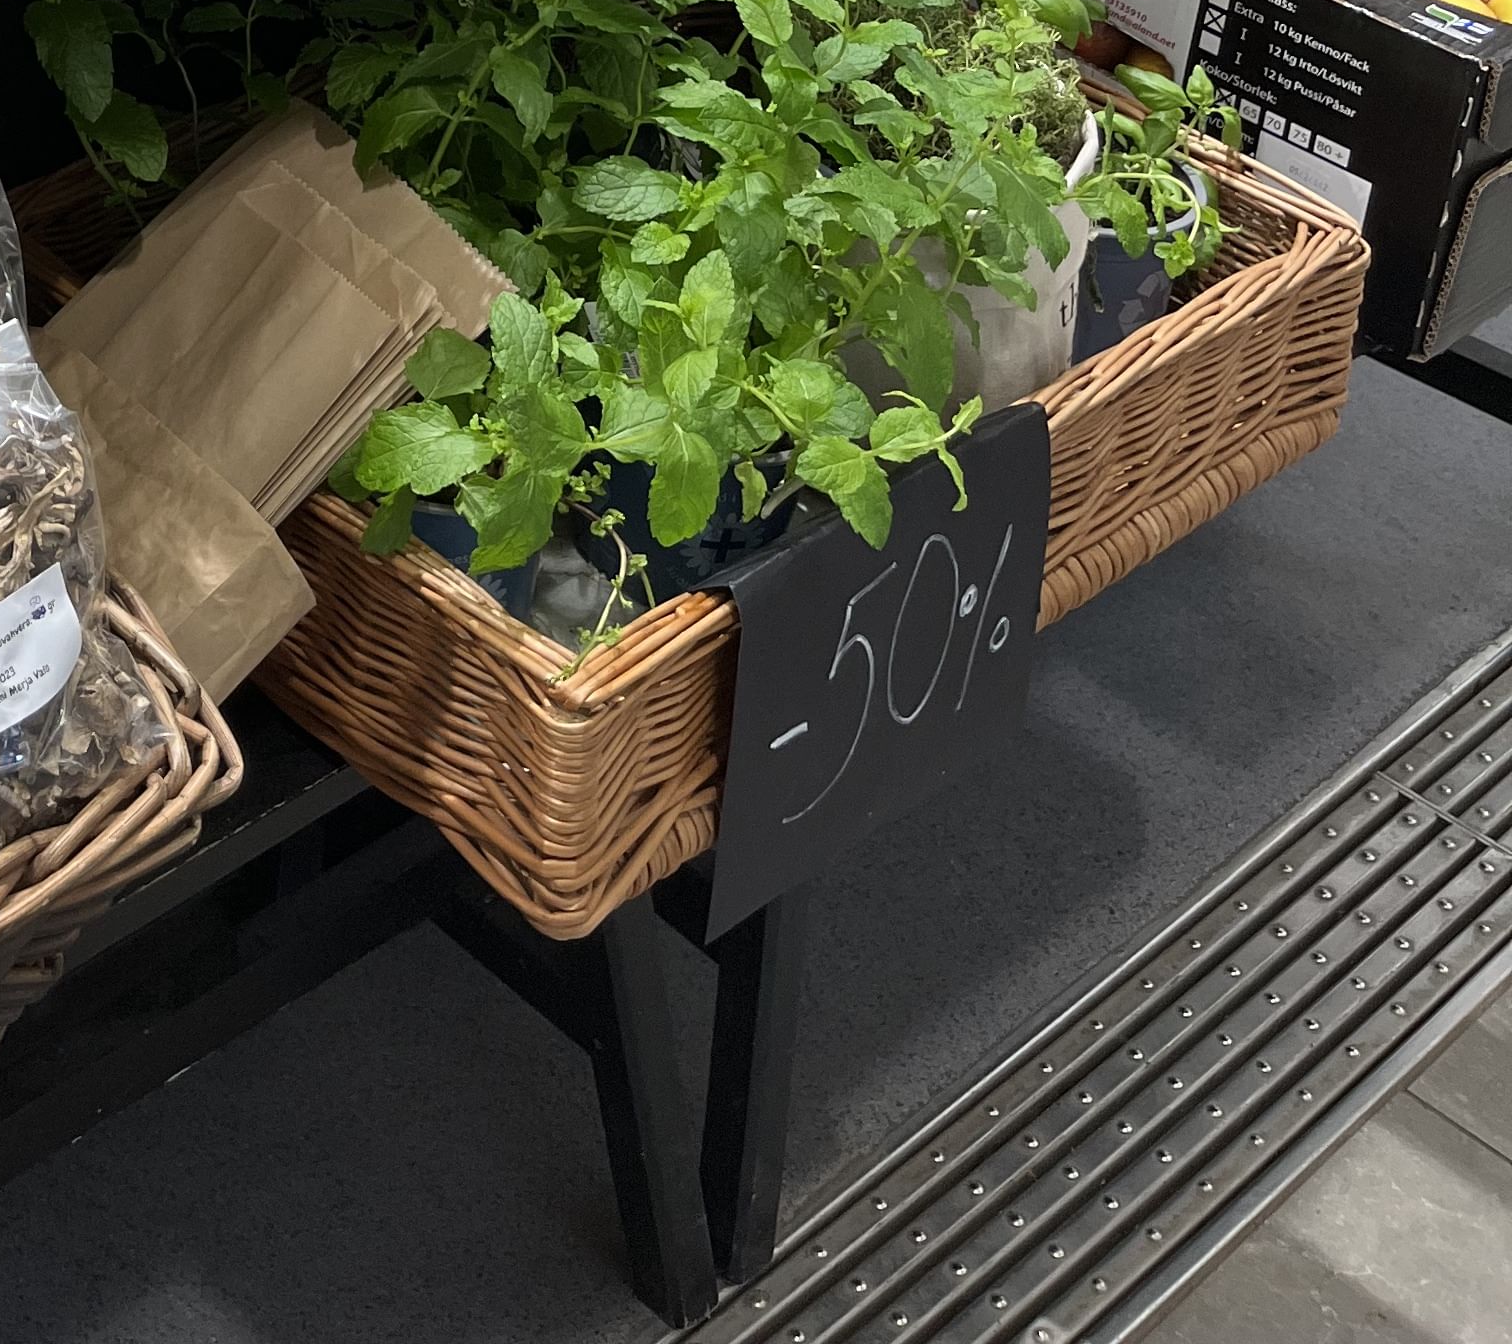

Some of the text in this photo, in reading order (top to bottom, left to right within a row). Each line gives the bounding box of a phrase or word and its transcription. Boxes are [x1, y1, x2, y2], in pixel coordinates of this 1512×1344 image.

[1234, 1, 1265, 24] Extra
[1268, 43, 1363, 96] 12 kg Irto/Lösvikt
[1273, 20, 1371, 73] 10 kg Kenno/Fack
[1199, 58, 1278, 104] Koko/Storlek:
[1263, 66, 1357, 119] 12 kg Pussi/Påsar
[1242, 105, 1257, 120] 65
[1266, 116, 1281, 131] 70
[1293, 129, 1307, 144] 75
[46, 599, 56, 614] gr
[9, 676, 34, 697] Merja
[34, 663, 51, 681] Valo
[769, 523, 1013, 824] -50%
